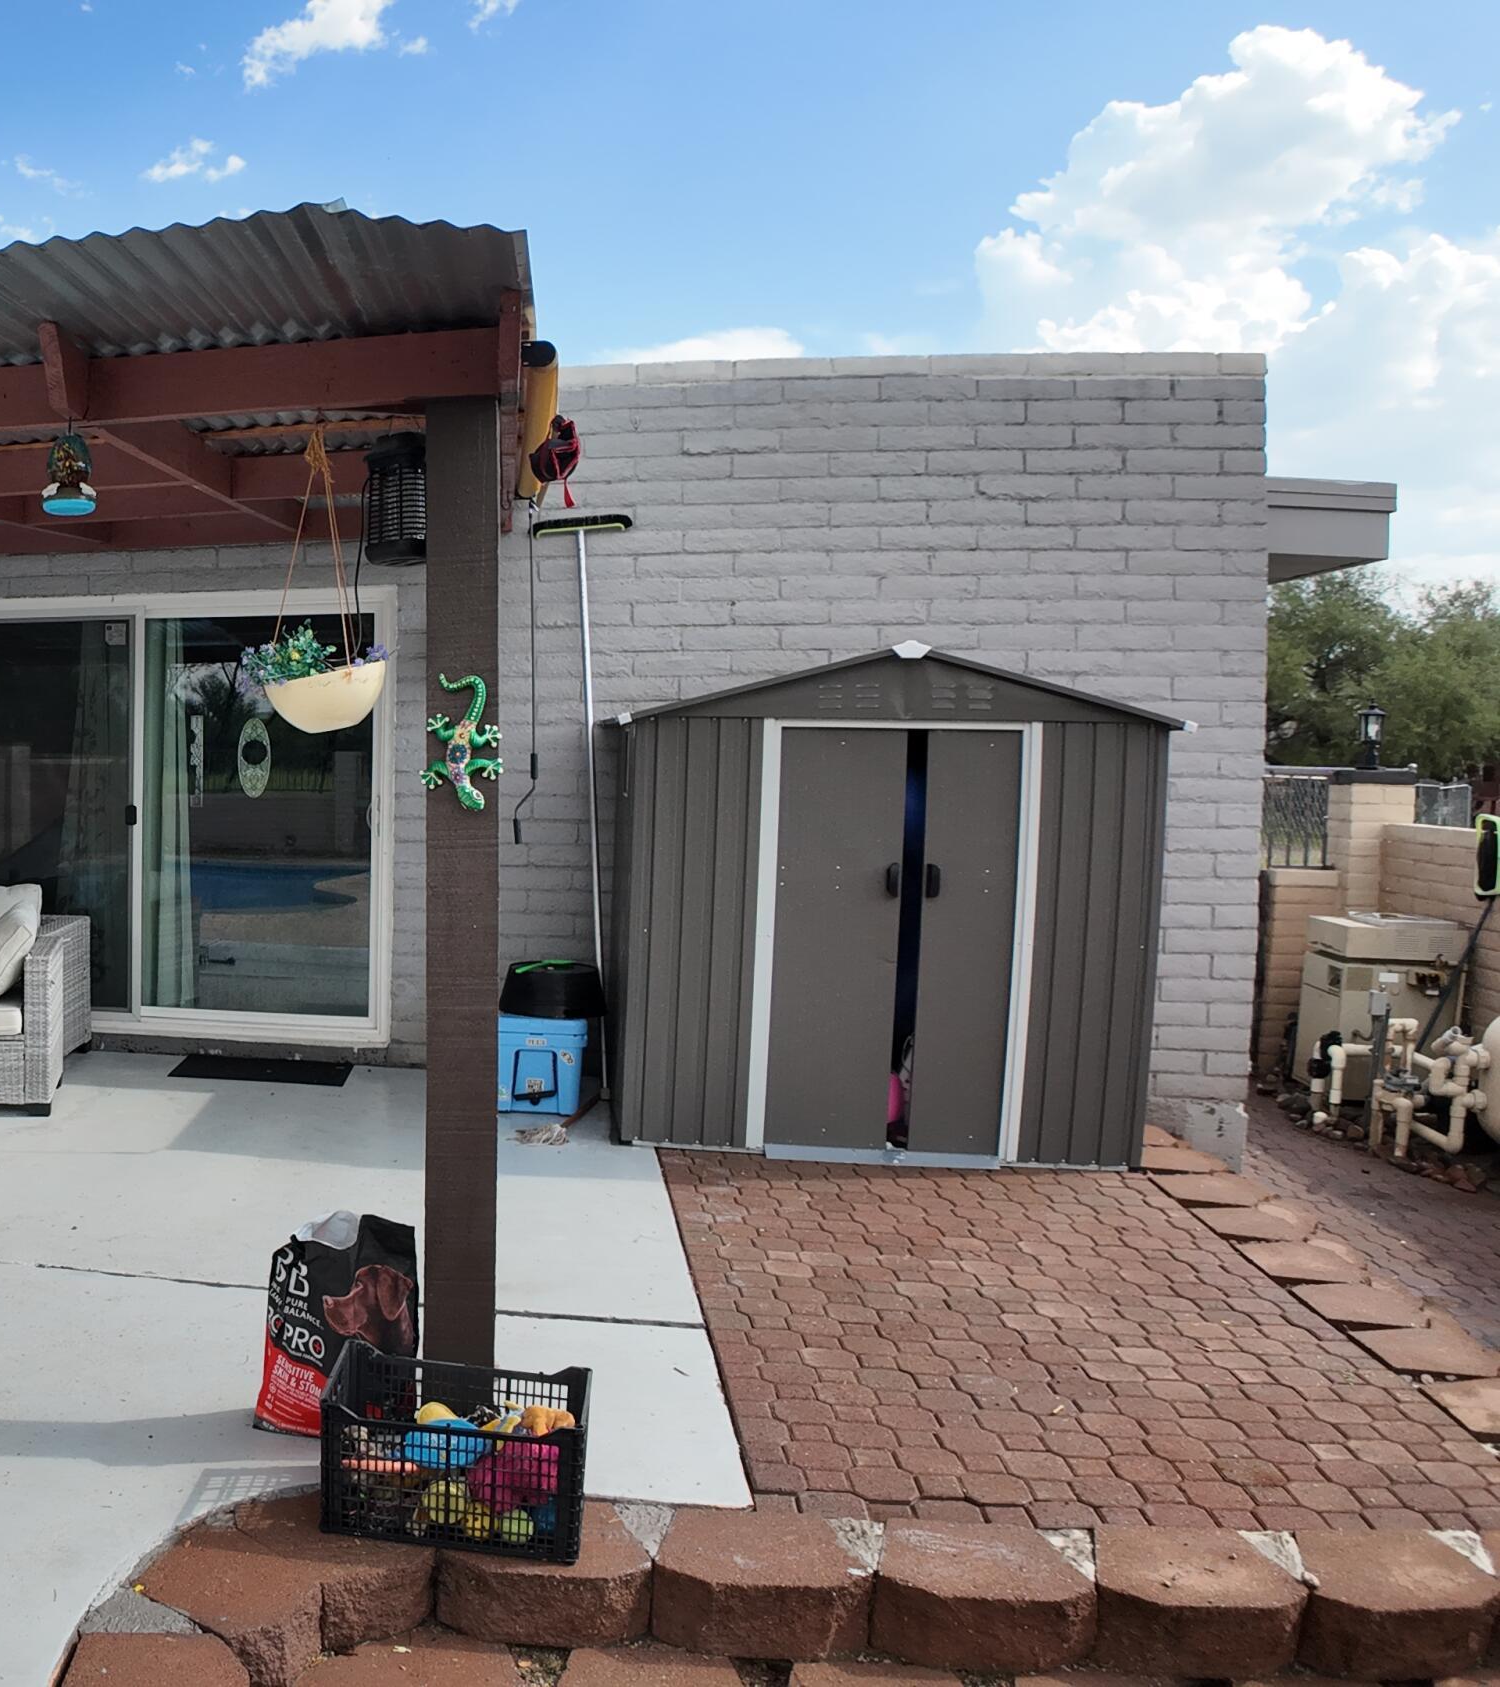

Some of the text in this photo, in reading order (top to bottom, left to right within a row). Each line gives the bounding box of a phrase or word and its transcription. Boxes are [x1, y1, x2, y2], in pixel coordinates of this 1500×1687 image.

[283, 1305, 322, 1328] BALANCE
[285, 1296, 308, 1311] PURE
[283, 1322, 325, 1359] PRO
[272, 1364, 289, 1382] SKIN
[289, 1376, 297, 1388] &
[298, 1380, 322, 1398] STOM
[276, 1354, 315, 1382] SENSITIVE
